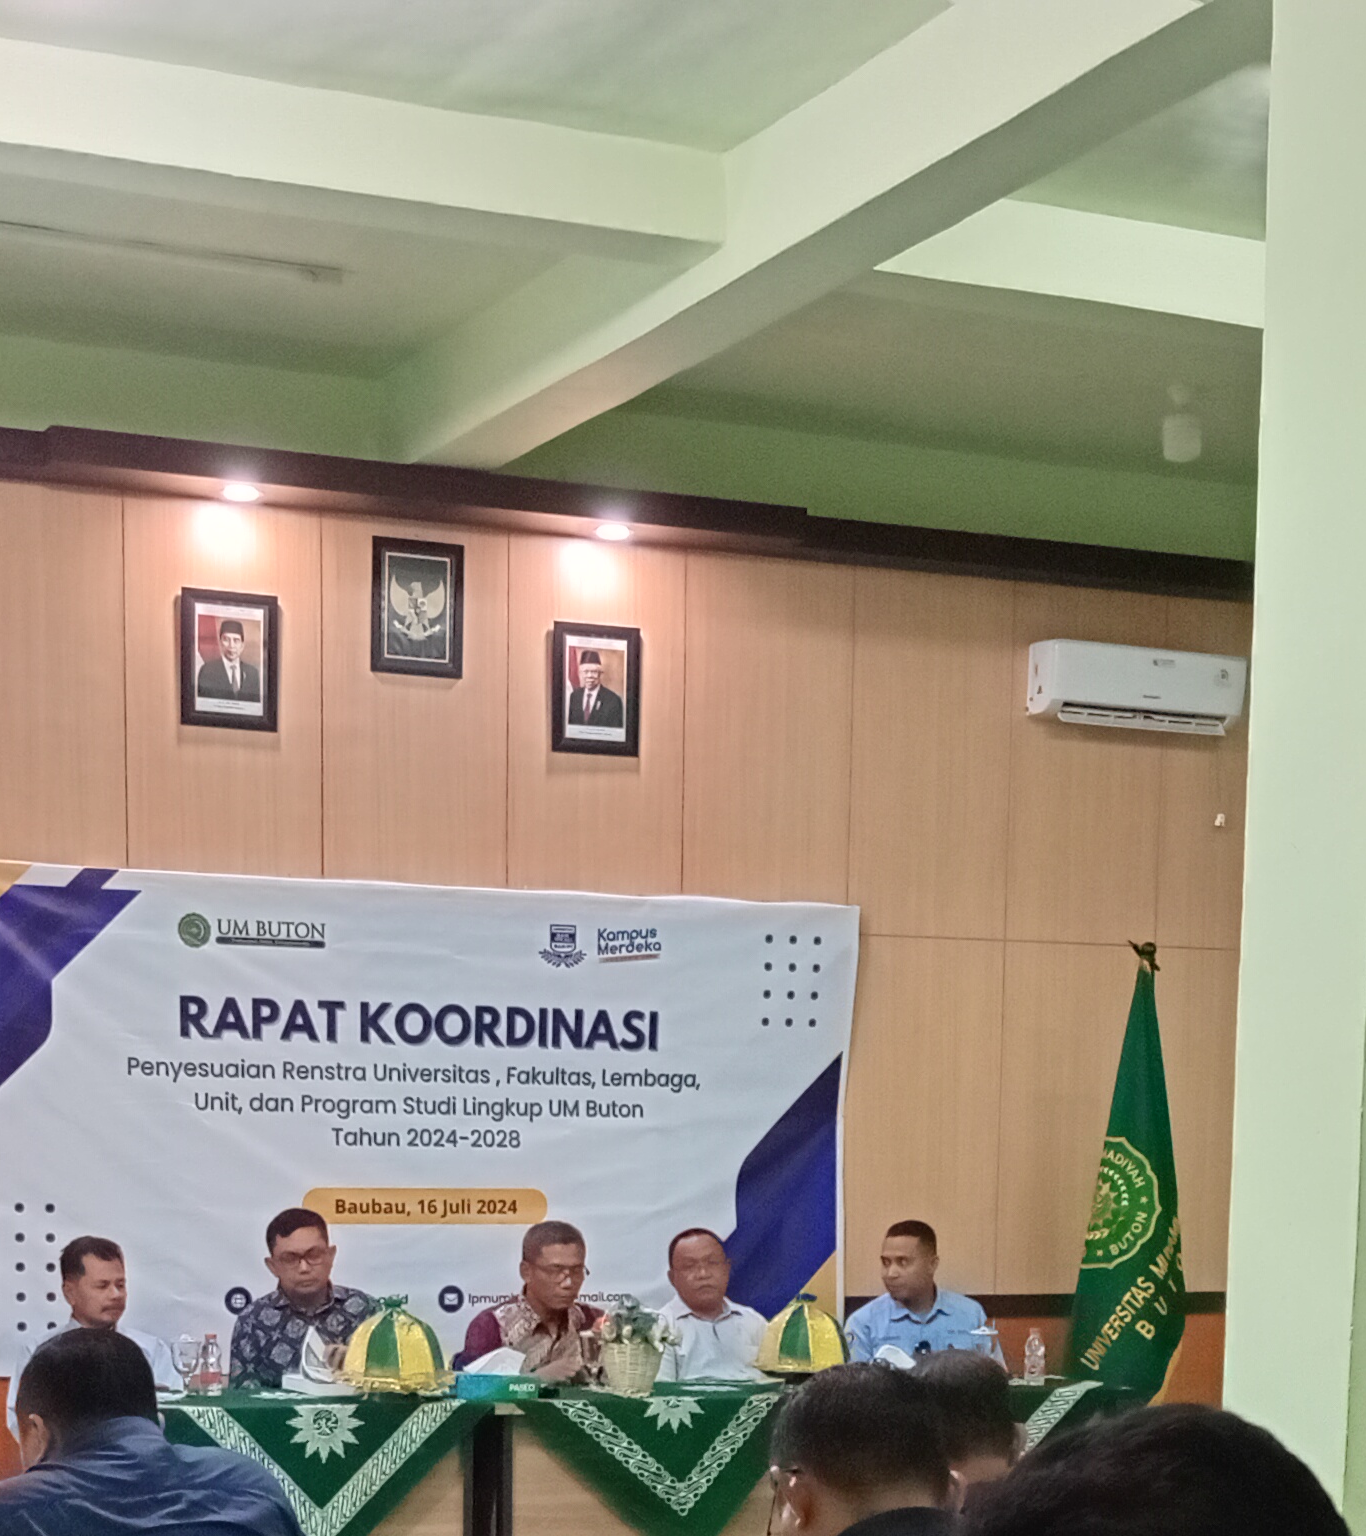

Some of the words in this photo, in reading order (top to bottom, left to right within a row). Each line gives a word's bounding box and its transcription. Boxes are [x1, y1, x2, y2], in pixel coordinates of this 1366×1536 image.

[217, 918, 250, 936] UM
[255, 920, 326, 939] BUTON
[597, 928, 657, 943] Kampus
[597, 940, 662, 955] Merdeka
[179, 995, 346, 1043] RAPAT
[359, 1001, 659, 1052] KOORDINASI
[126, 1056, 276, 1084] Penyesuaian
[282, 1060, 367, 1082] Renstra
[373, 1063, 491, 1086] Universitas
[506, 1065, 597, 1090] Fakultas,
[601, 1068, 702, 1094] Lembaga,
[194, 1091, 244, 1116] Unit,
[249, 1092, 294, 1114] dan
[301, 1094, 397, 1121] Program
[403, 1096, 457, 1116] Studi
[463, 1096, 544, 1123] Lingkup
[549, 1099, 580, 1118] UM
[586, 1100, 645, 1119] Buton
[332, 1127, 401, 1148] Tahun
[407, 1128, 522, 1150] 2024-2028
[335, 1197, 412, 1218] Baubau,
[417, 1198, 438, 1215] 16
[441, 1197, 472, 1219] Juli
[476, 1198, 519, 1216] 2024
[1108, 1210, 1149, 1257] BUTON
[1080, 1276, 1156, 1371] UNIVERSITAS
